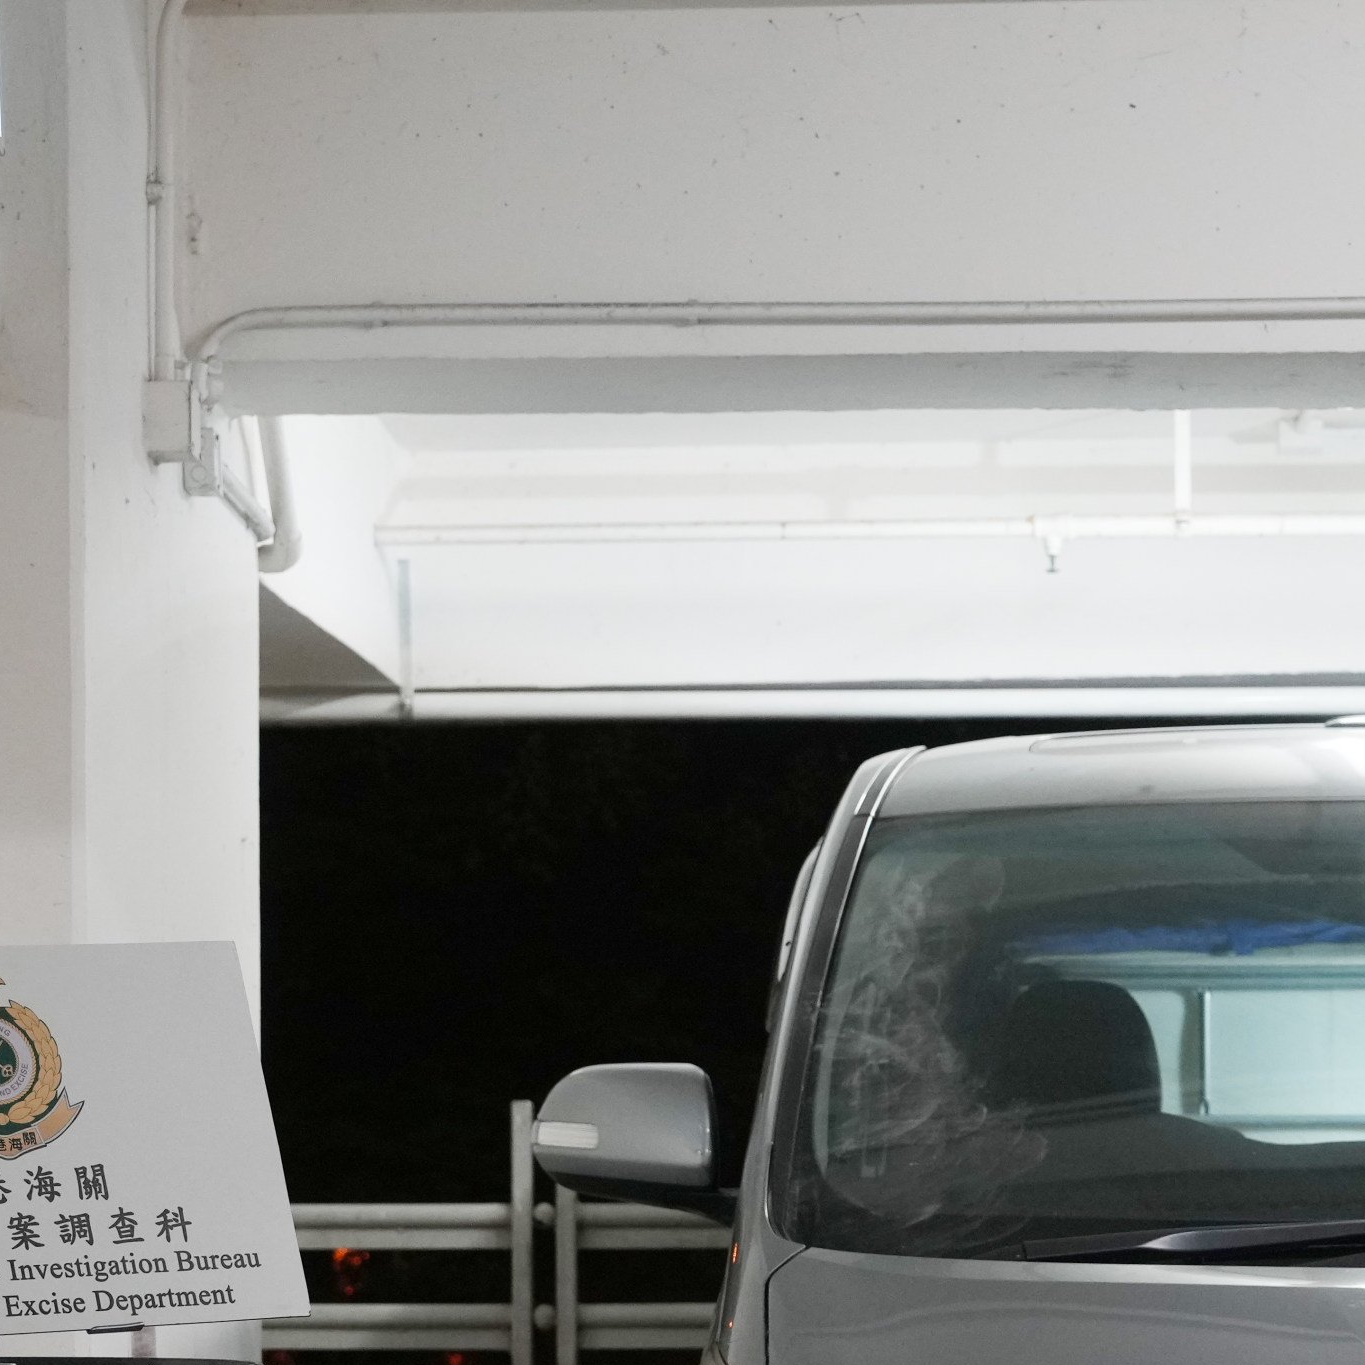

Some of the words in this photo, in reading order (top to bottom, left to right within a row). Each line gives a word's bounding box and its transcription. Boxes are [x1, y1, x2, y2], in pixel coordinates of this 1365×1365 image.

[11, 1063, 30, 1094] EXCISE
[7, 1252, 171, 1283] Investigation
[174, 1247, 263, 1272] Bureau
[3, 1290, 86, 1318] Excise
[93, 1282, 237, 1316] Department
